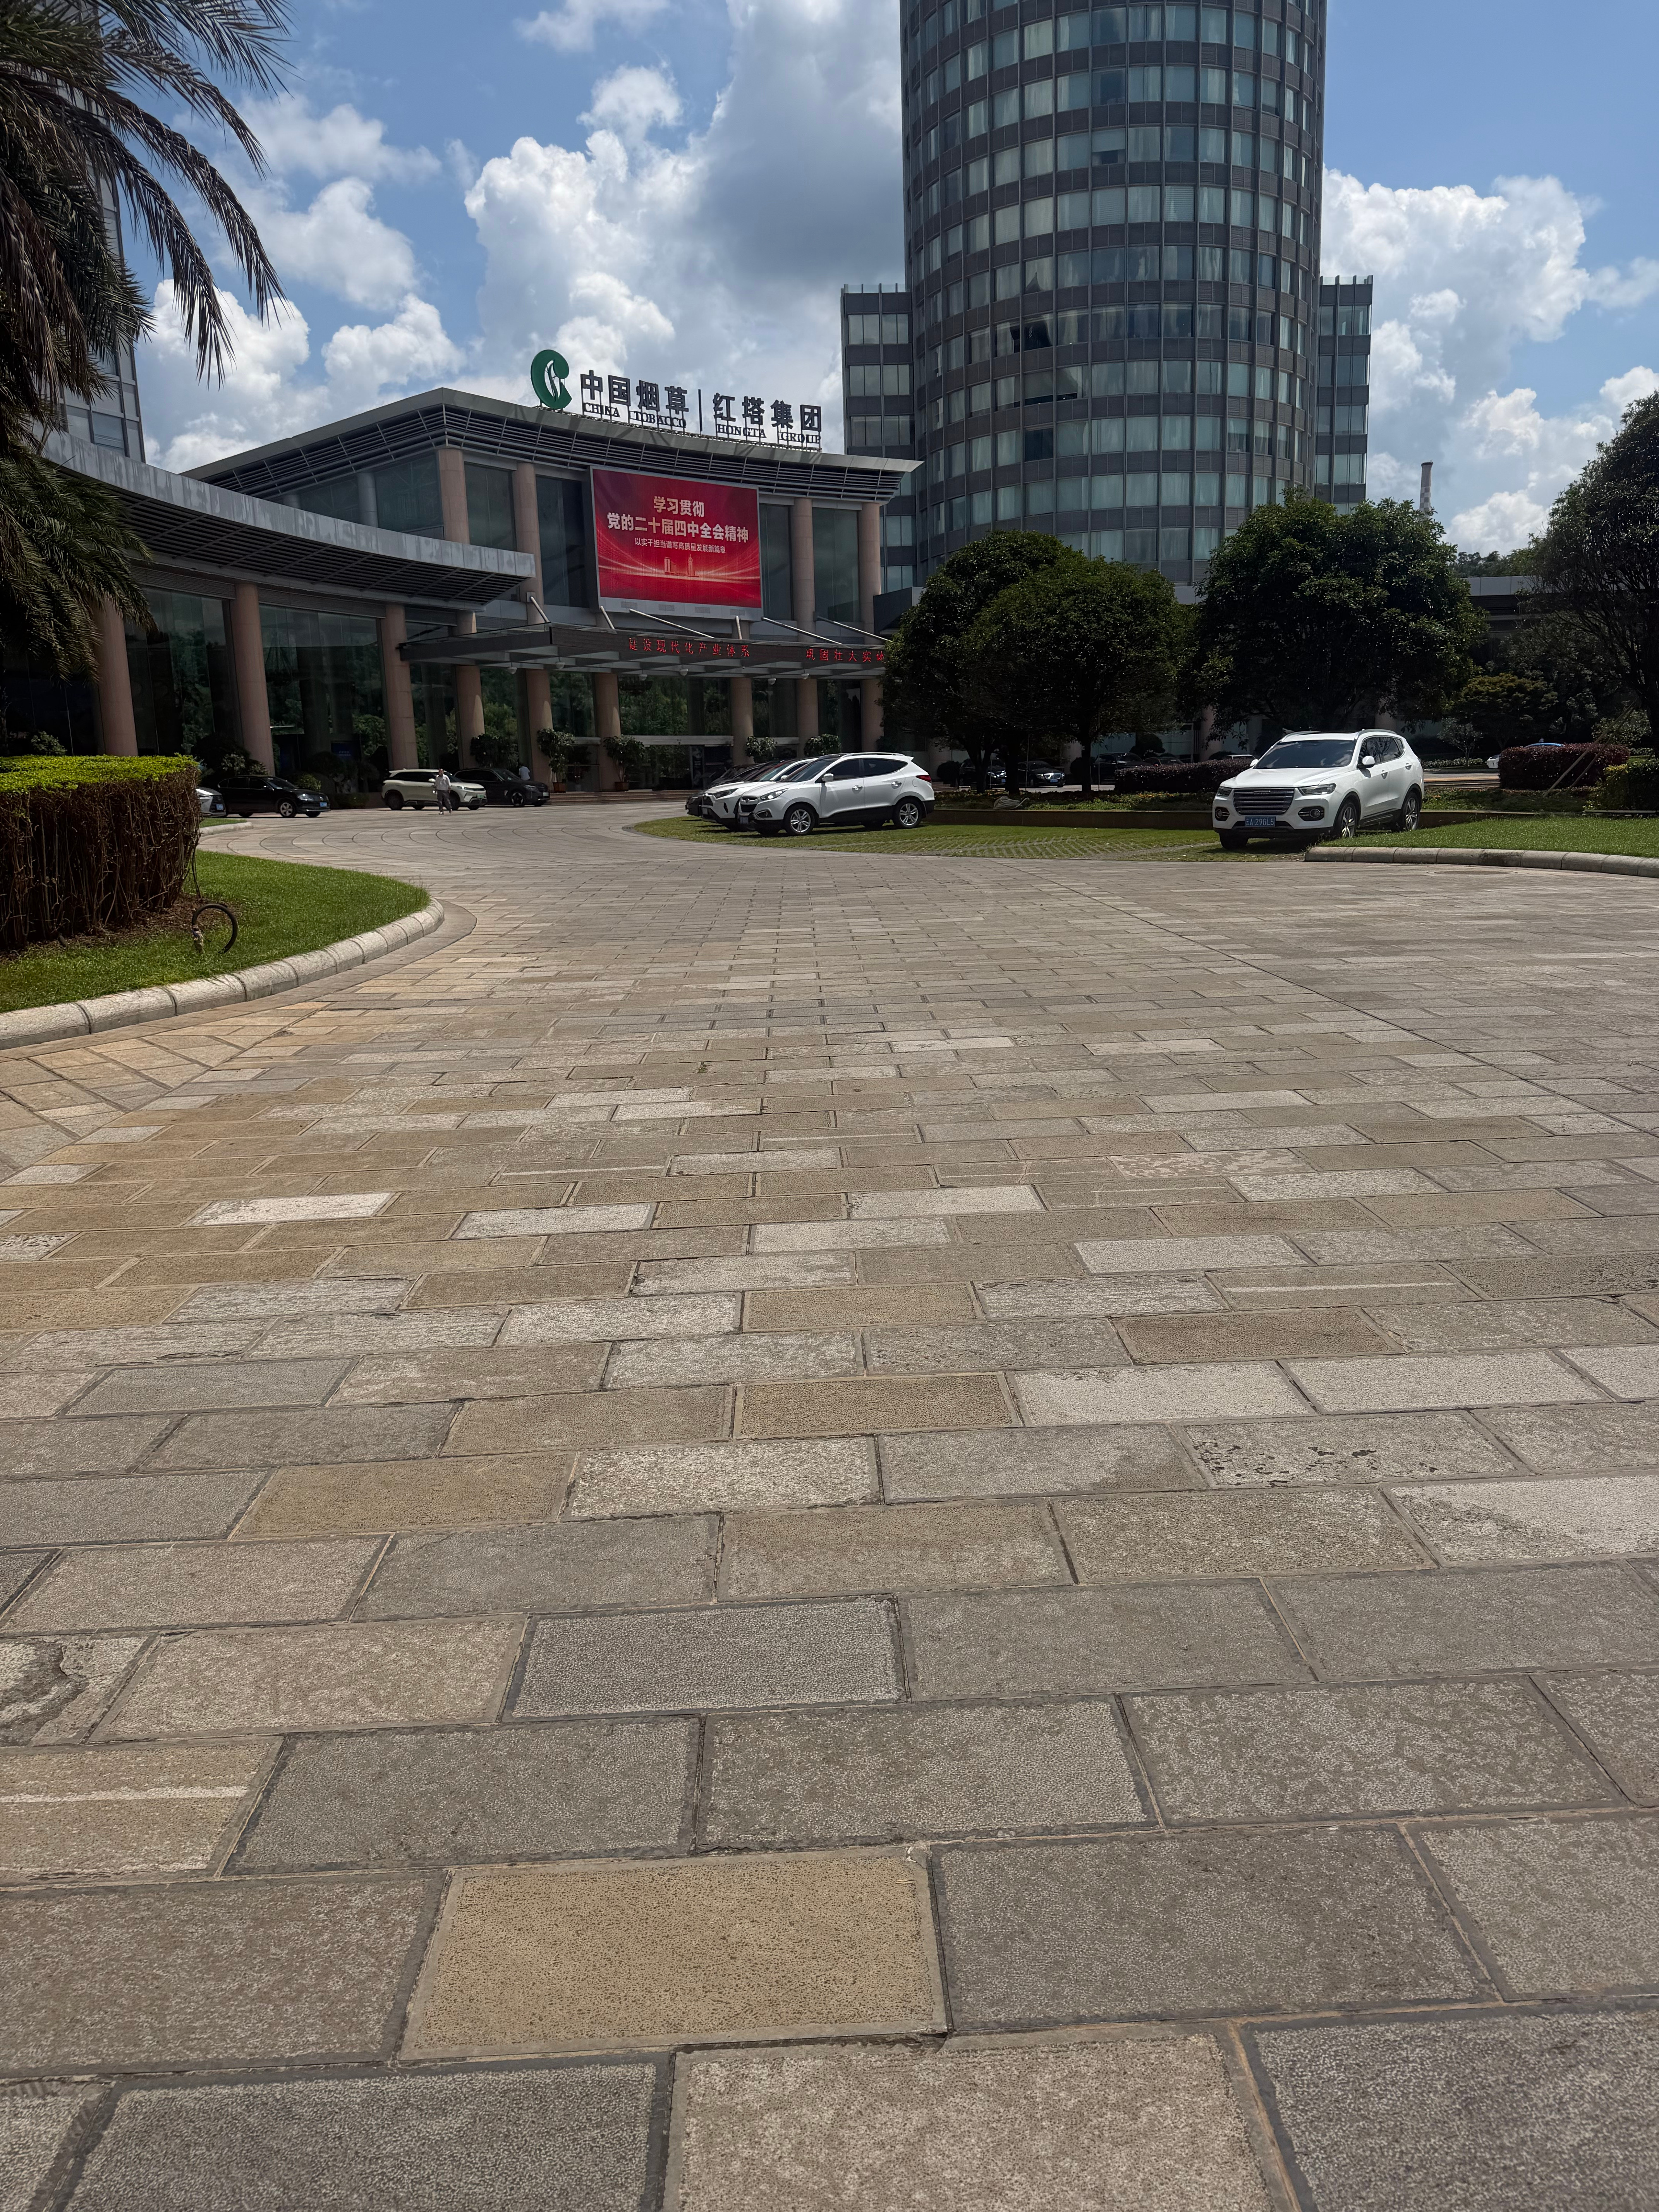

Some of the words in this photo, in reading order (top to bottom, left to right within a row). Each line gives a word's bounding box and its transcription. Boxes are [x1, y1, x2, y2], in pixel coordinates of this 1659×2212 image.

[580, 370, 689, 414] 中国烟草
[713, 393, 821, 432] 红塔集团
[583, 403, 621, 417] CHINA
[634, 411, 687, 428] TOBACCO
[717, 424, 766, 438] HONGTA
[781, 432, 821, 443] GROUP
[653, 496, 704, 517] 学习贯彻
[607, 512, 749, 543] 党的二十届四中全会精神
[635, 538, 726, 554] 以实干担当谱写高质量发展新篇章
[629, 637, 750, 657] 建设现代化产业体系
